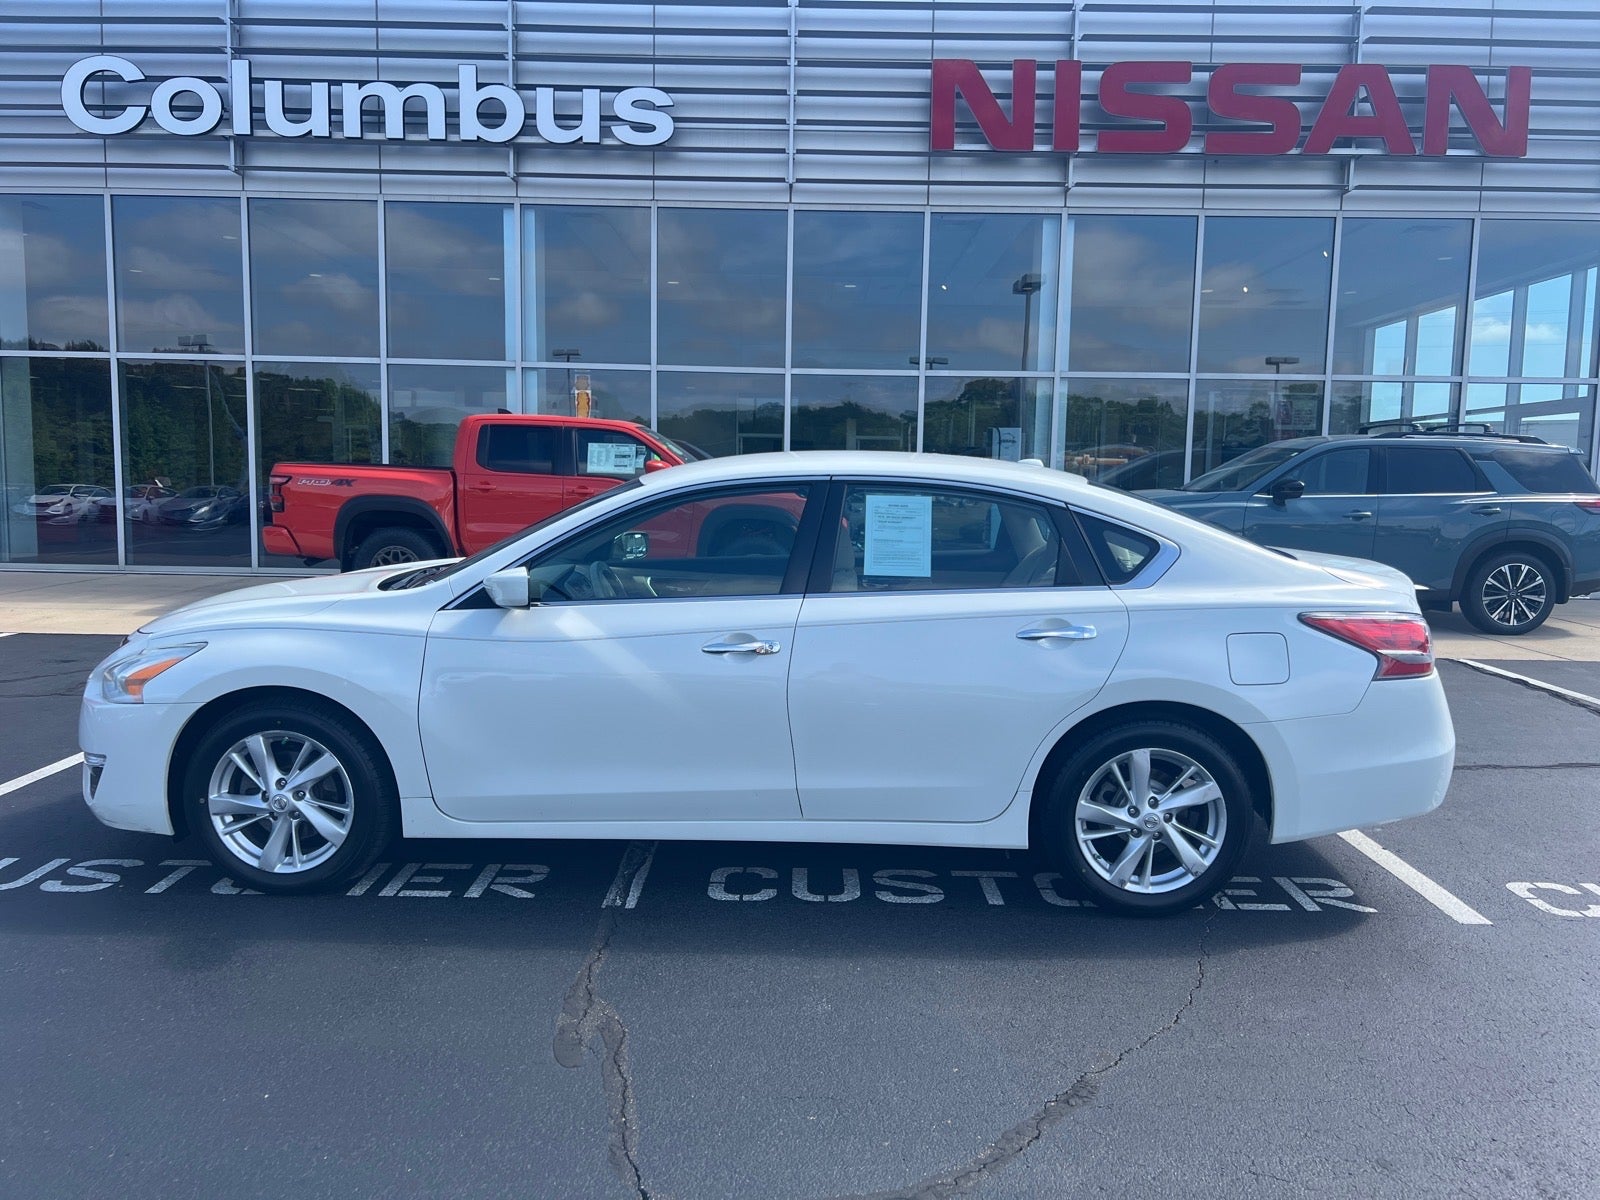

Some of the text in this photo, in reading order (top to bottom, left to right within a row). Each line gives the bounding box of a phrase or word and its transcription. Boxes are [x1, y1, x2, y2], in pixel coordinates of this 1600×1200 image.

[60, 55, 676, 147] Columbus
[930, 58, 1533, 158] NISSAN
[707, 866, 1378, 913] CUSTER
